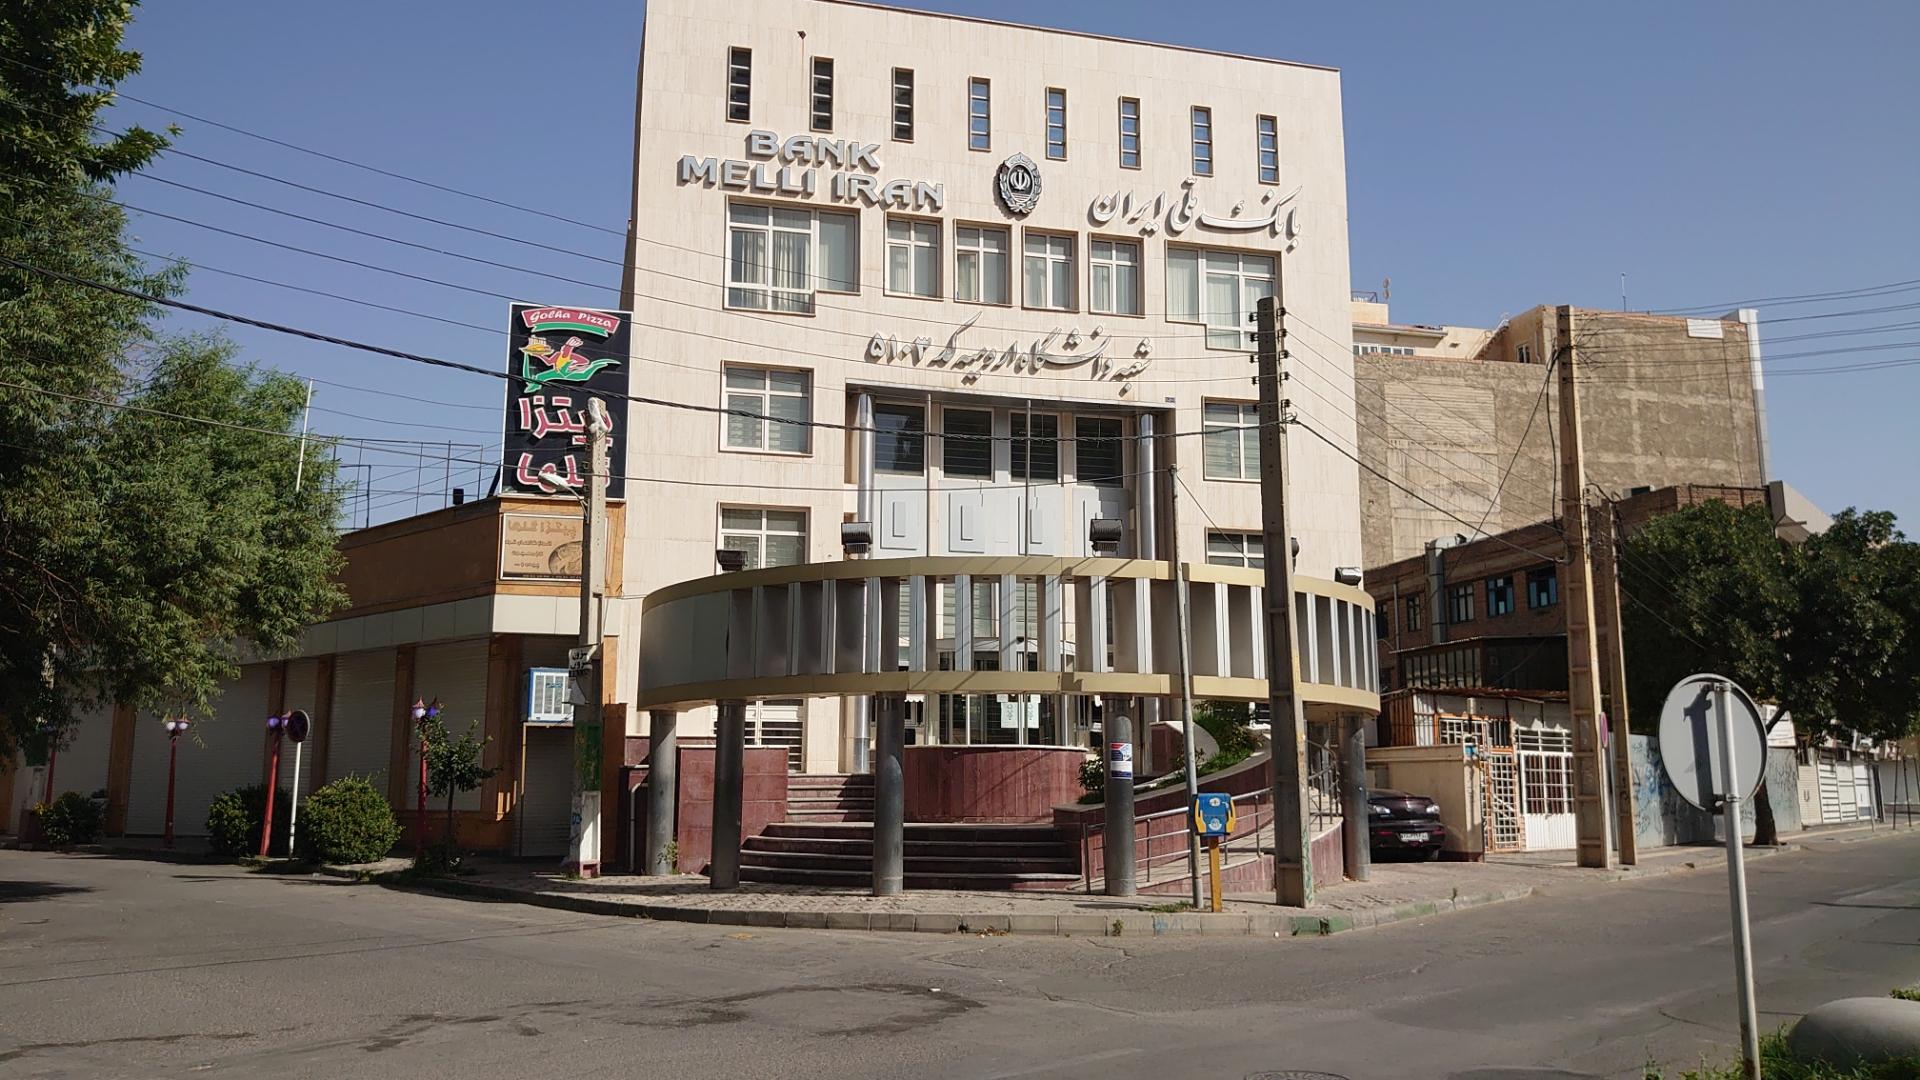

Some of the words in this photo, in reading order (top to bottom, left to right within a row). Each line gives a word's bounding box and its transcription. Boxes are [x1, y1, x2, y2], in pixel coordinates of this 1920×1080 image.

[750, 129, 881, 171] BANK
[681, 154, 816, 194] MELLI
[835, 171, 944, 209] IRAN
[1092, 189, 1166, 234] ایران
[1199, 184, 1303, 249] بانک
[529, 310, 571, 323] Golha
[577, 313, 612, 328] Pizza
[934, 310, 983, 367] کد
[868, 332, 932, 366] ۵۱۰۳
[957, 339, 1018, 385] ارومیه
[1018, 324, 1113, 381] دانشگاه
[1112, 336, 1153, 394] شعبه
